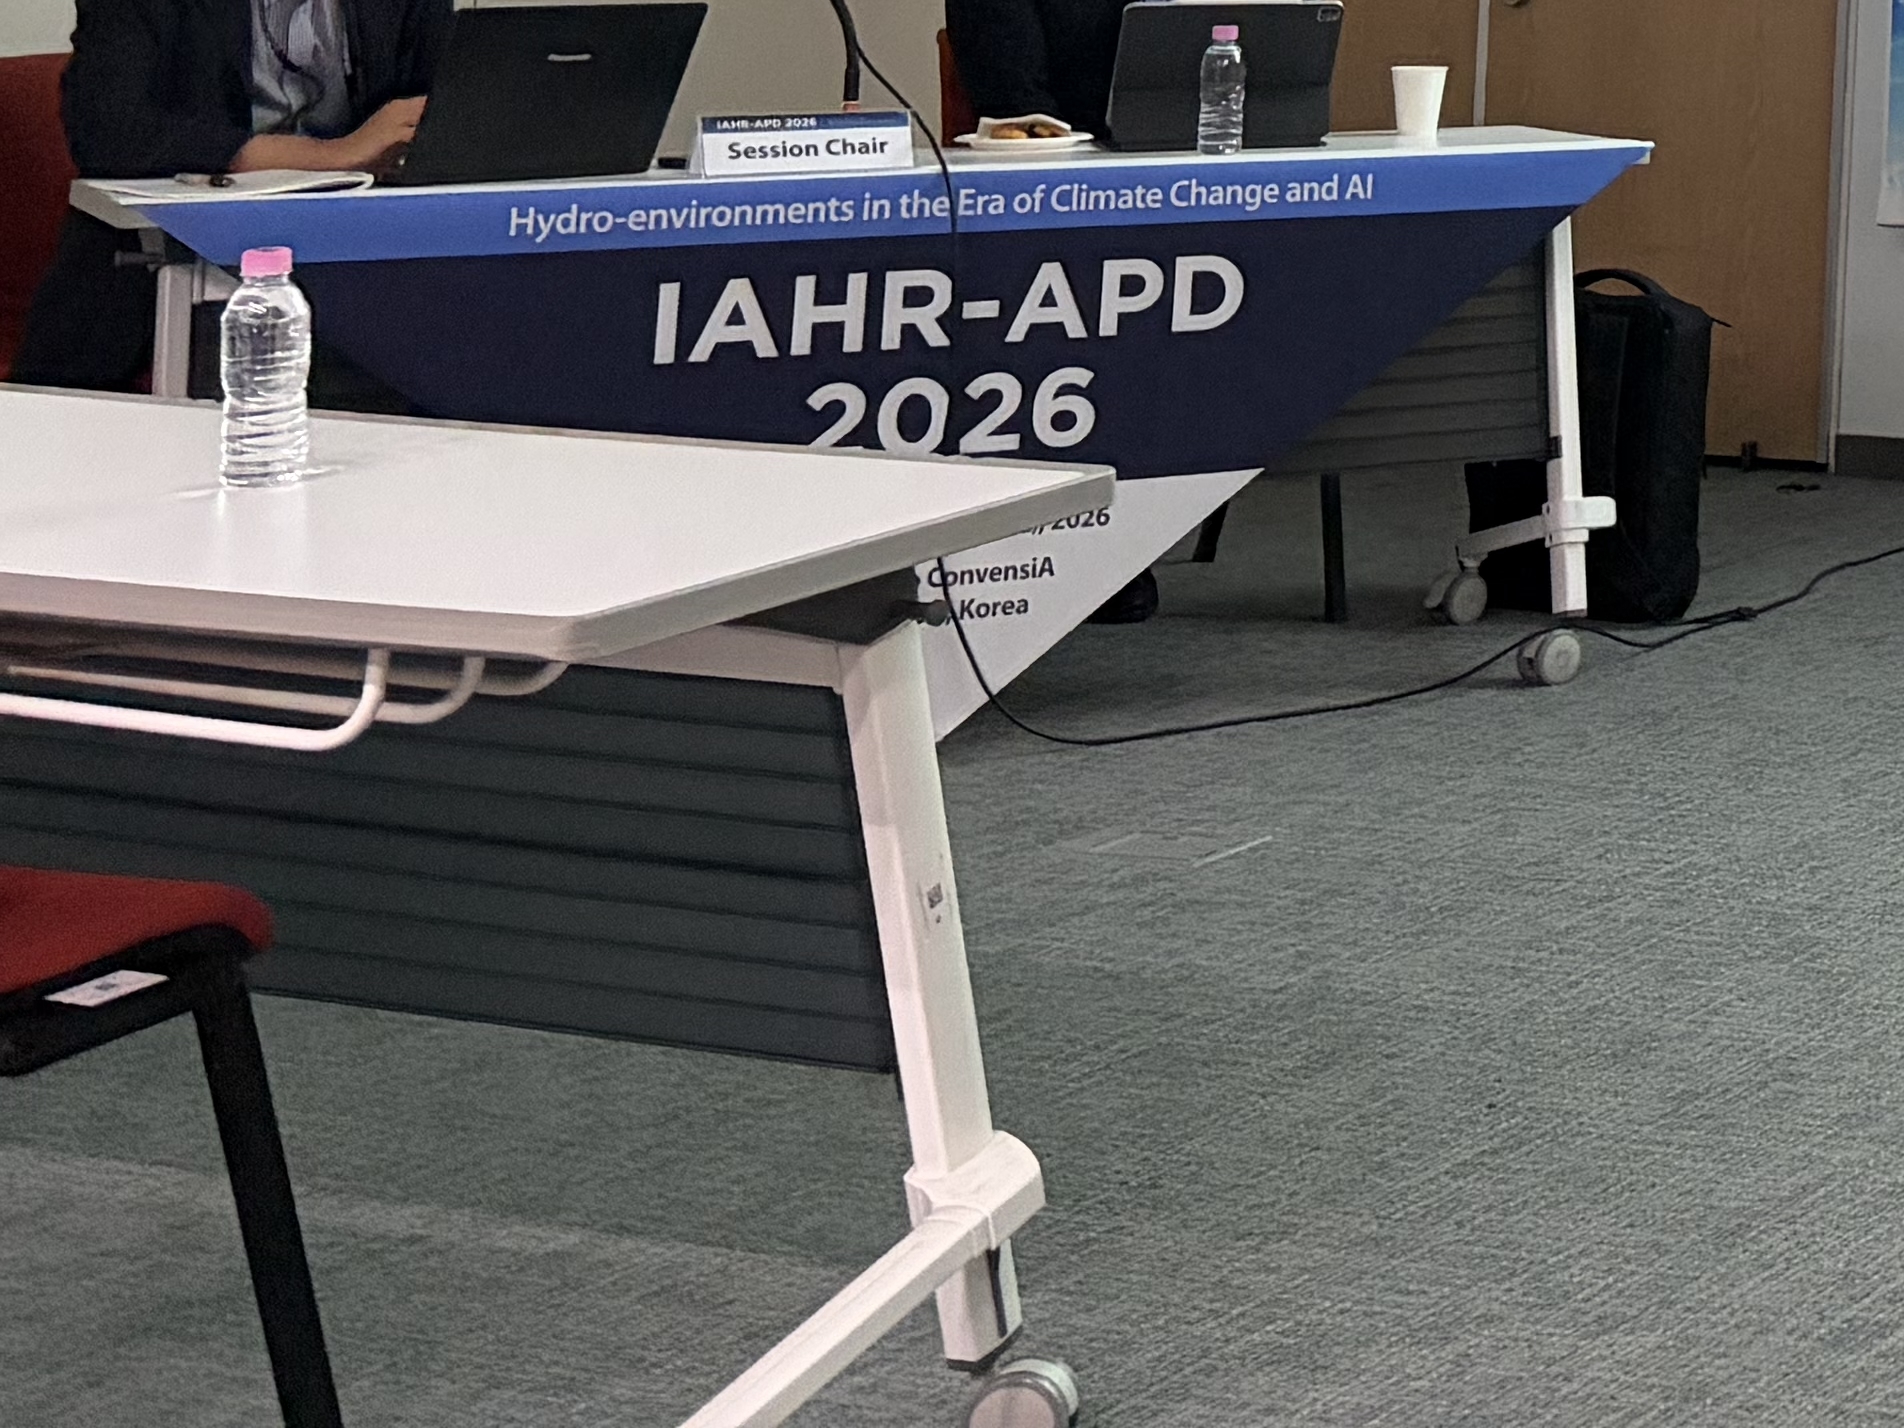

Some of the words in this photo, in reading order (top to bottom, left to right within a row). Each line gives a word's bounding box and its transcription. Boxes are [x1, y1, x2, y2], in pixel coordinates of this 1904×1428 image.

[717, 119, 781, 129] IAHR-APD
[785, 117, 817, 128] 2026
[728, 140, 819, 160] Session
[826, 136, 890, 156] Chair
[508, 202, 854, 243] Hydro-environments
[863, 192, 892, 220] in
[899, 190, 950, 219] the
[958, 188, 1005, 216] Era
[1013, 185, 1044, 215] of
[1050, 182, 1163, 213] Climate
[1169, 178, 1279, 216] Change
[1286, 176, 1339, 205] and
[1346, 174, 1374, 201] AI
[652, 254, 1246, 365] IAHR-APD
[805, 366, 1096, 458] 2026
[959, 596, 1029, 620] Korea
